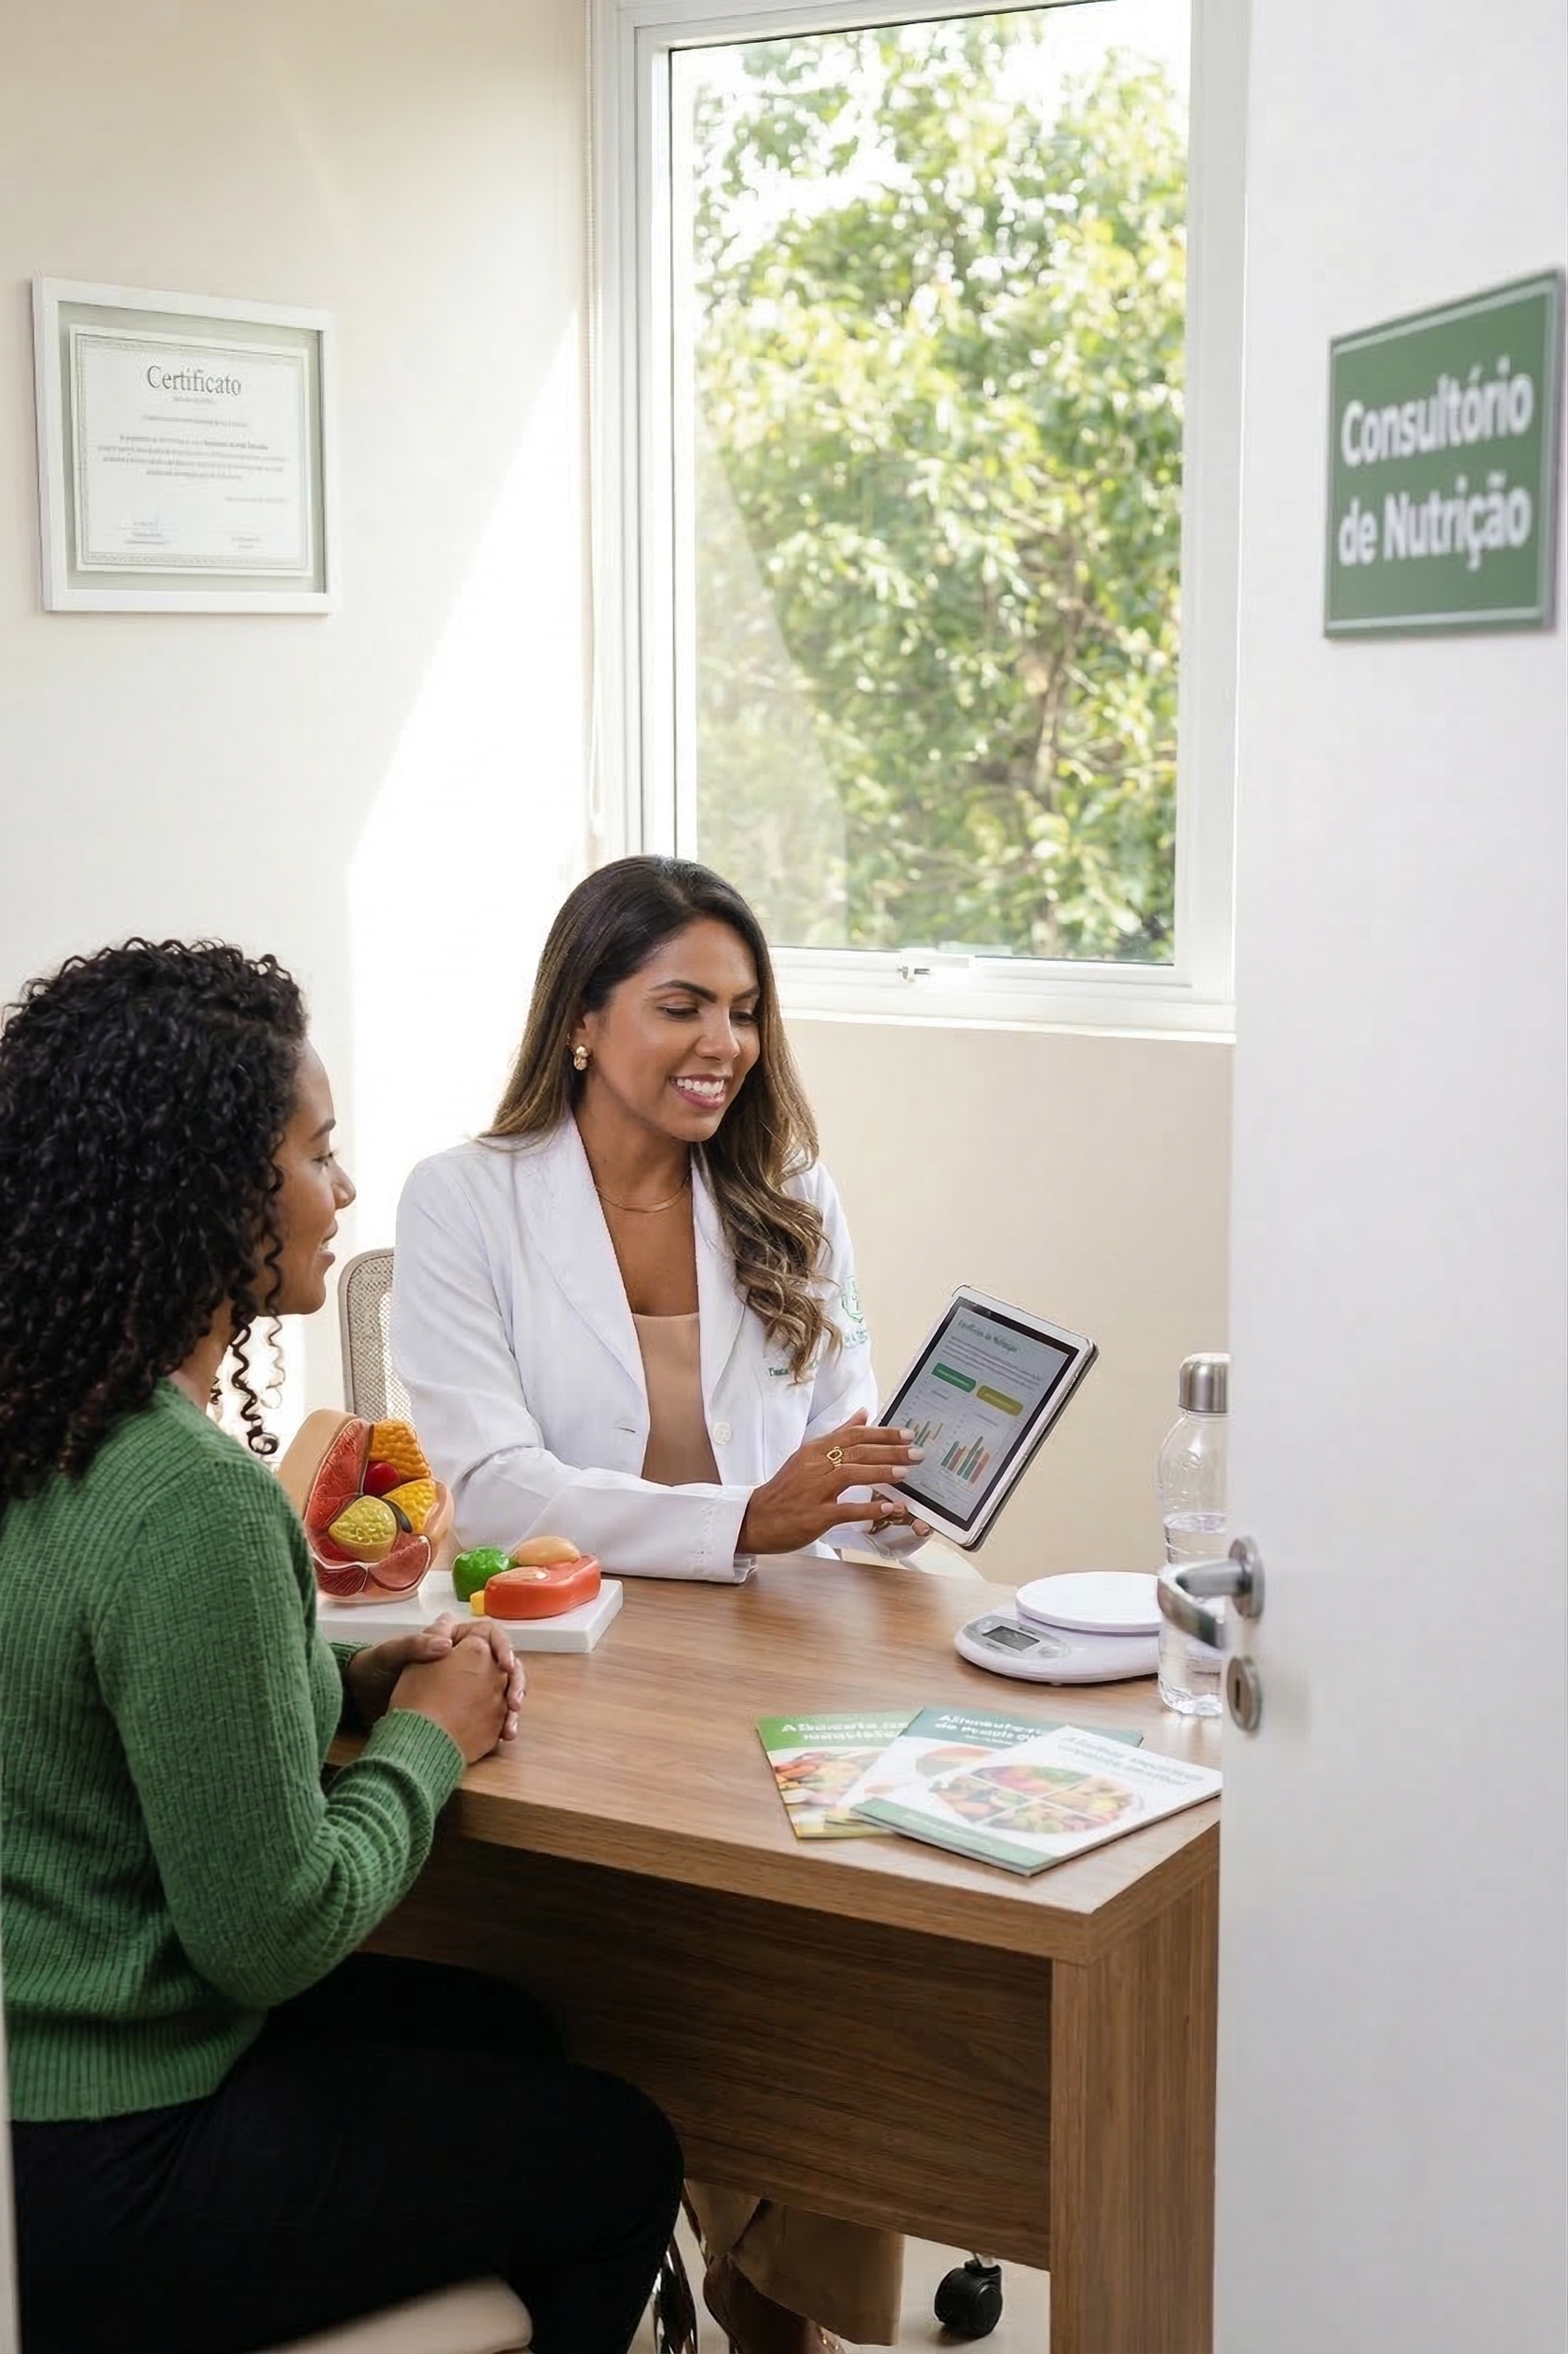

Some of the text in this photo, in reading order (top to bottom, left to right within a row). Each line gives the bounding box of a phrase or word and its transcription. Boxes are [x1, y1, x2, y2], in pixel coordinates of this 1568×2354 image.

[146, 365, 241, 396] Certificato
[1341, 355, 1534, 467] Consultório
[1338, 469, 1531, 572] de Nutrição
